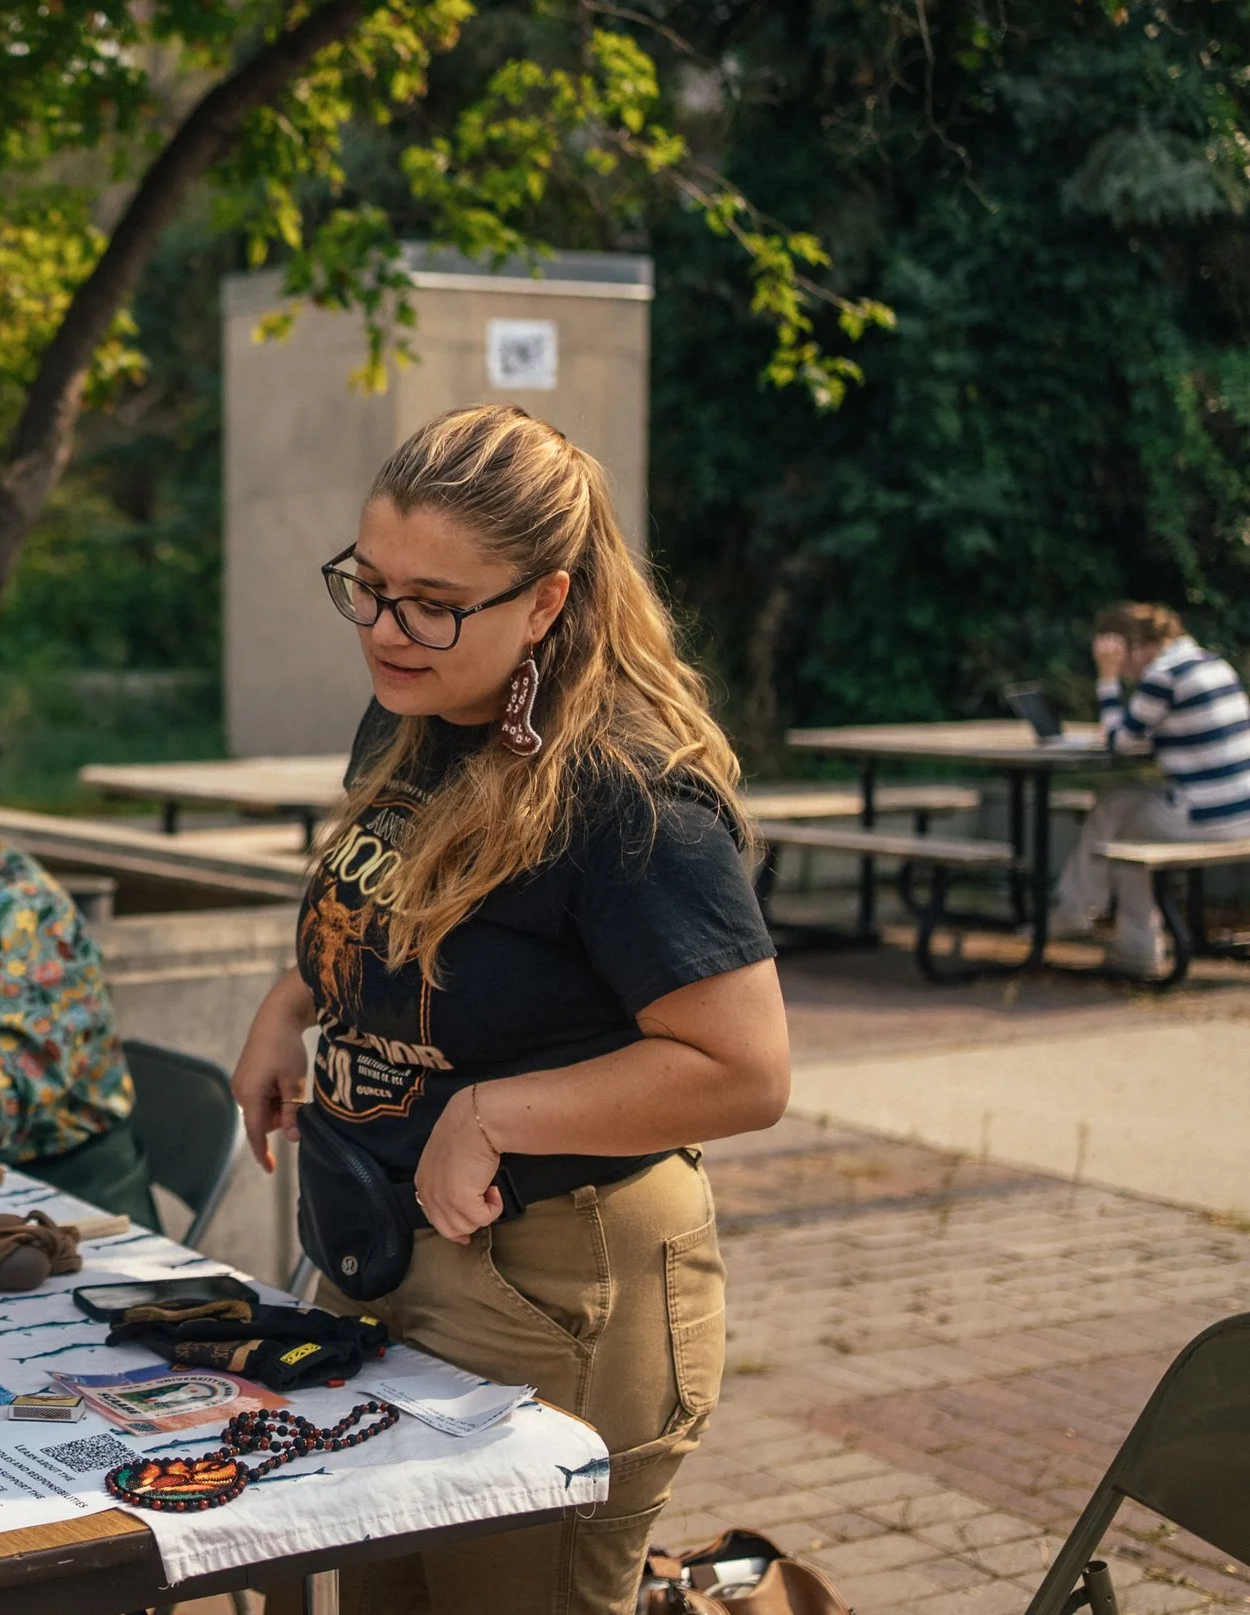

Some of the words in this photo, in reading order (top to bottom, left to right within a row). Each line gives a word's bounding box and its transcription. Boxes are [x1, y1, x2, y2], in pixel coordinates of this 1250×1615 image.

[366, 808, 416, 849] ANGR
[322, 823, 410, 914] MOO
[356, 1085, 393, 1099] OUNCES
[156, 1376, 218, 1385] UNIVERSITY
[14, 1444, 41, 1463] LEARN
[36, 1458, 61, 1476] ABOUT
[57, 1470, 77, 1482] THE
[11, 1462, 32, 1473] AND
[26, 1469, 88, 1509] RESPONSIBILITIES
[26, 1488, 47, 1501] THE
